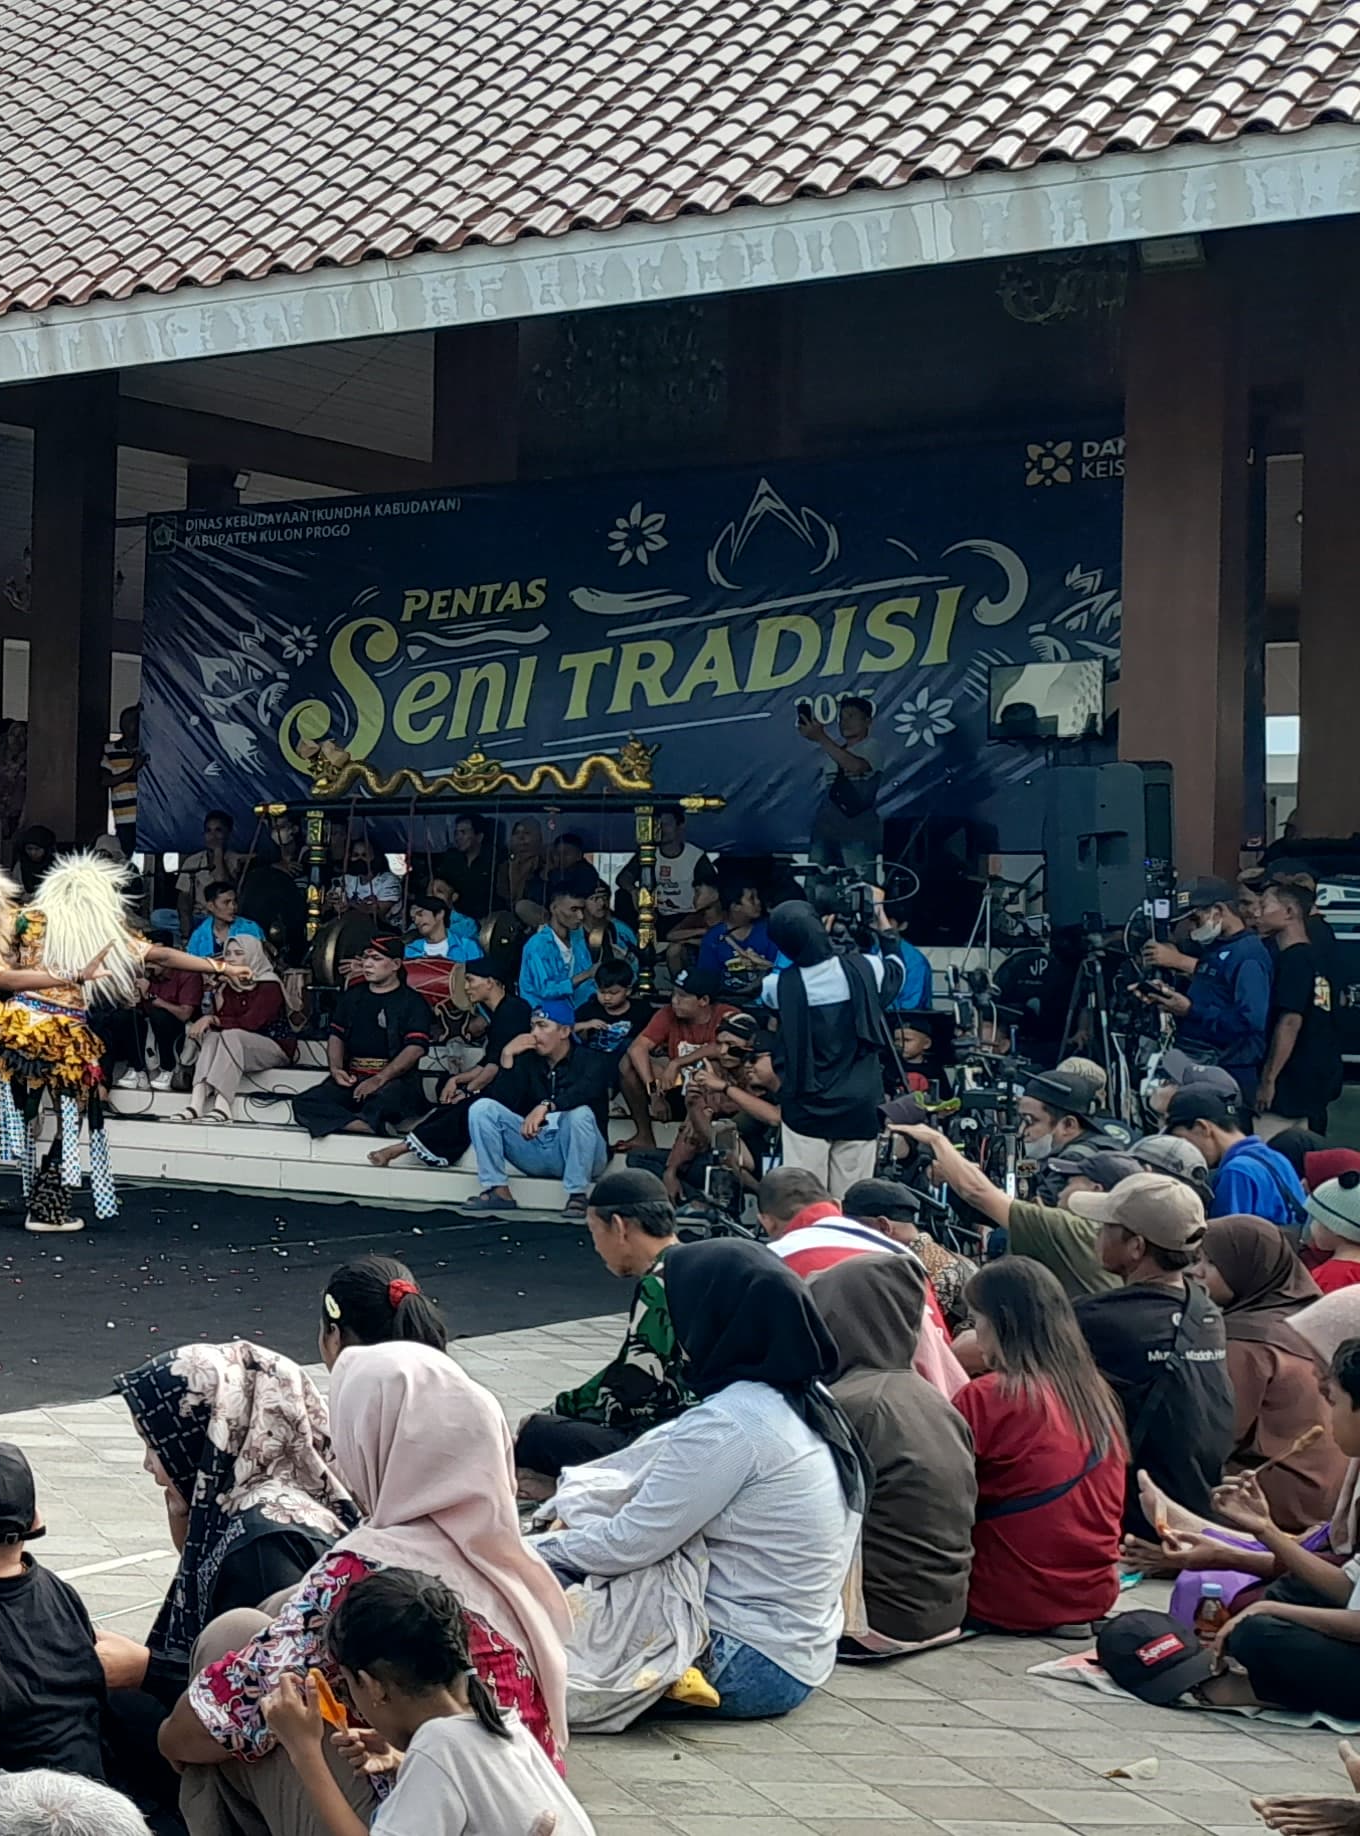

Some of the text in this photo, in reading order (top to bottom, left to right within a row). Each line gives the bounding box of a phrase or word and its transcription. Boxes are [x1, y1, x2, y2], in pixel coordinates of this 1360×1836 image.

[185, 497, 462, 532] DINAS KEBUDAYAAN (KUNDHA KABUDAYAN)
[184, 523, 351, 548] KABUPATEN KULON PROGO
[400, 578, 547, 622] PENTAS
[558, 585, 966, 721] TRADISI
